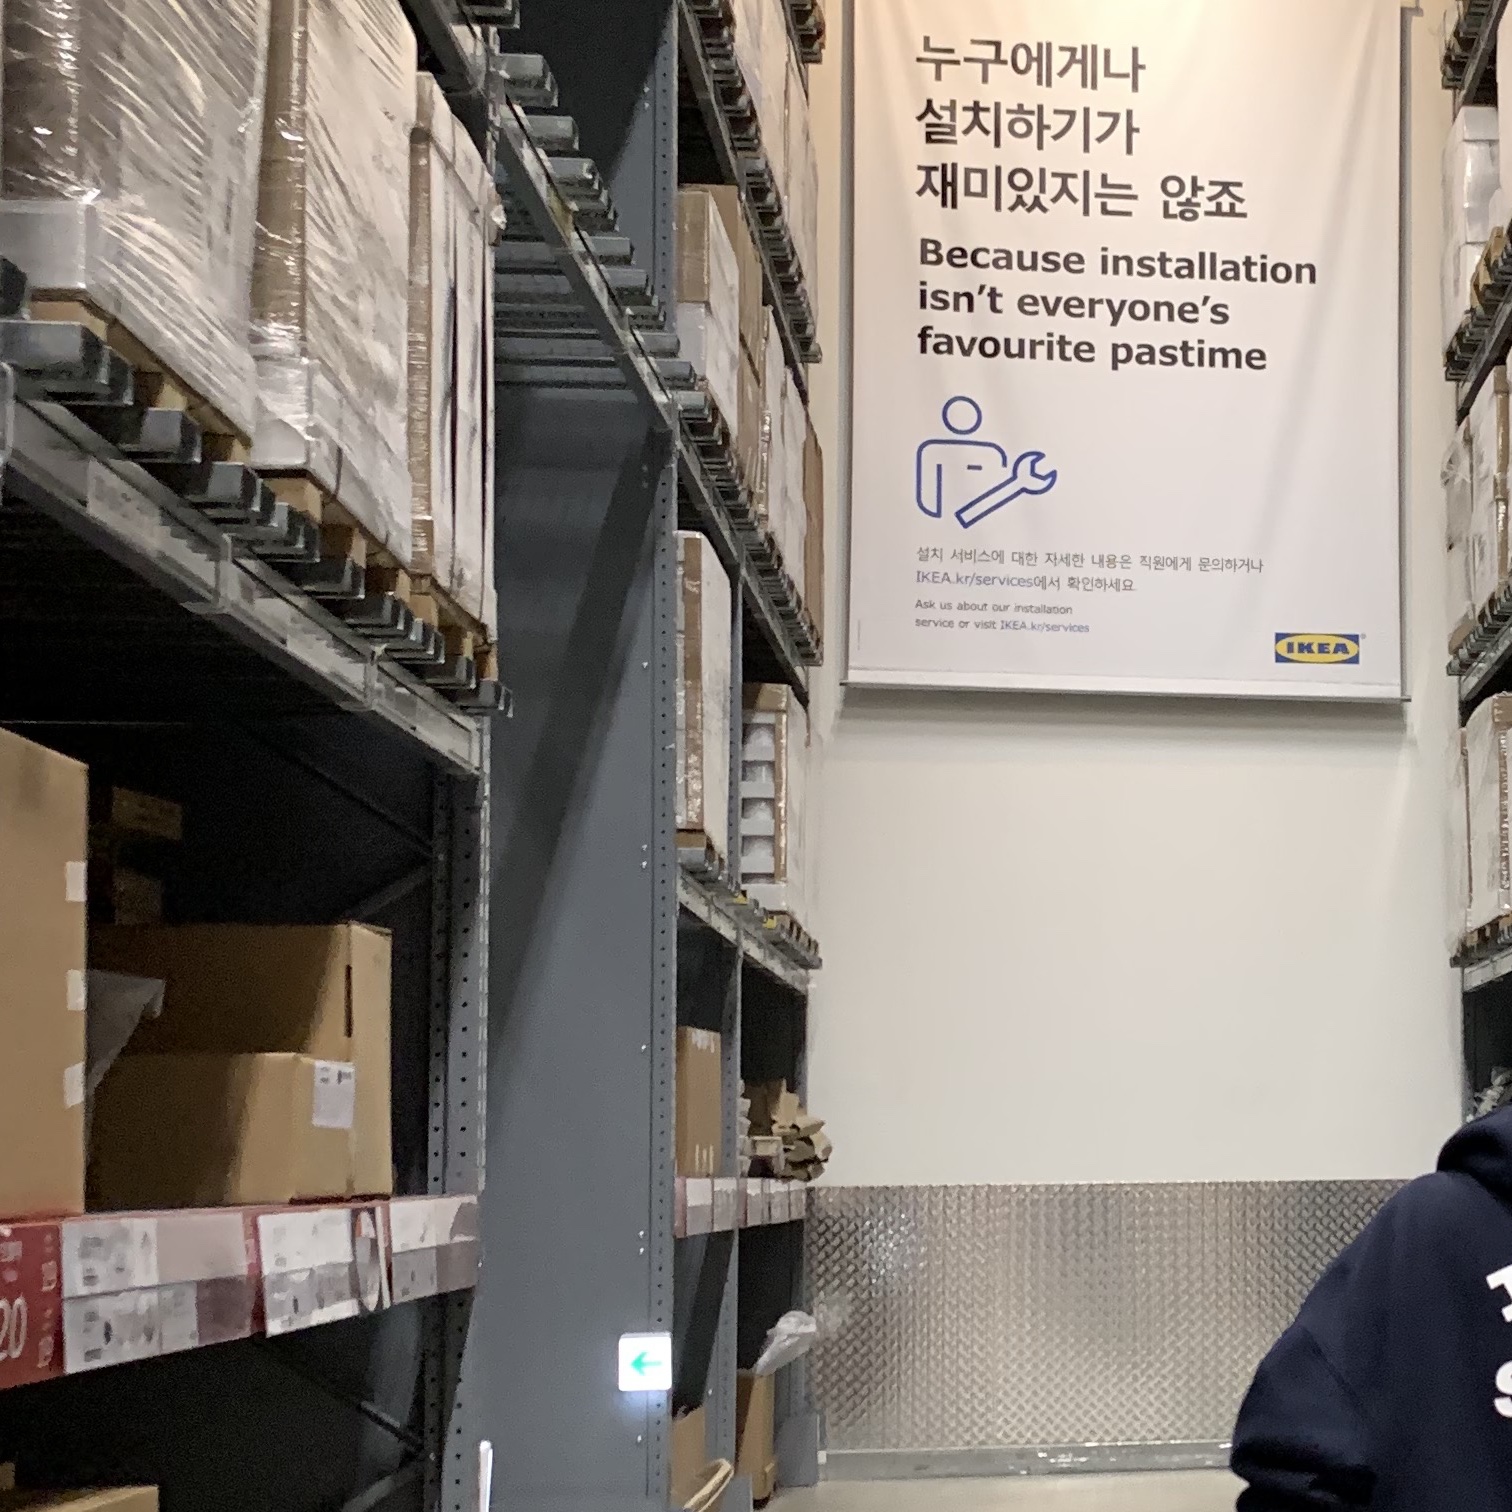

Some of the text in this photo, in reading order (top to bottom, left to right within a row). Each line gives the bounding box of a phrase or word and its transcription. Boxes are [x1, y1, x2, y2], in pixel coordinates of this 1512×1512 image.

[916, 35, 1146, 92] 누구에게나
[916, 98, 1140, 155] 설치하기가
[916, 162, 1248, 222] 재미있지는 않죠
[919, 238, 1317, 284] Because installation
[917, 325, 1267, 371] favourite pastime
[916, 546, 1265, 574] 설치 서비스에 대한 자세한 내용은 직원에게 문의하거나
[914, 598, 1073, 615] Ask us about our installation
[914, 617, 954, 629] service
[957, 619, 971, 629] or
[973, 618, 997, 630] visit
[1286, 641, 1350, 655] IKEA
